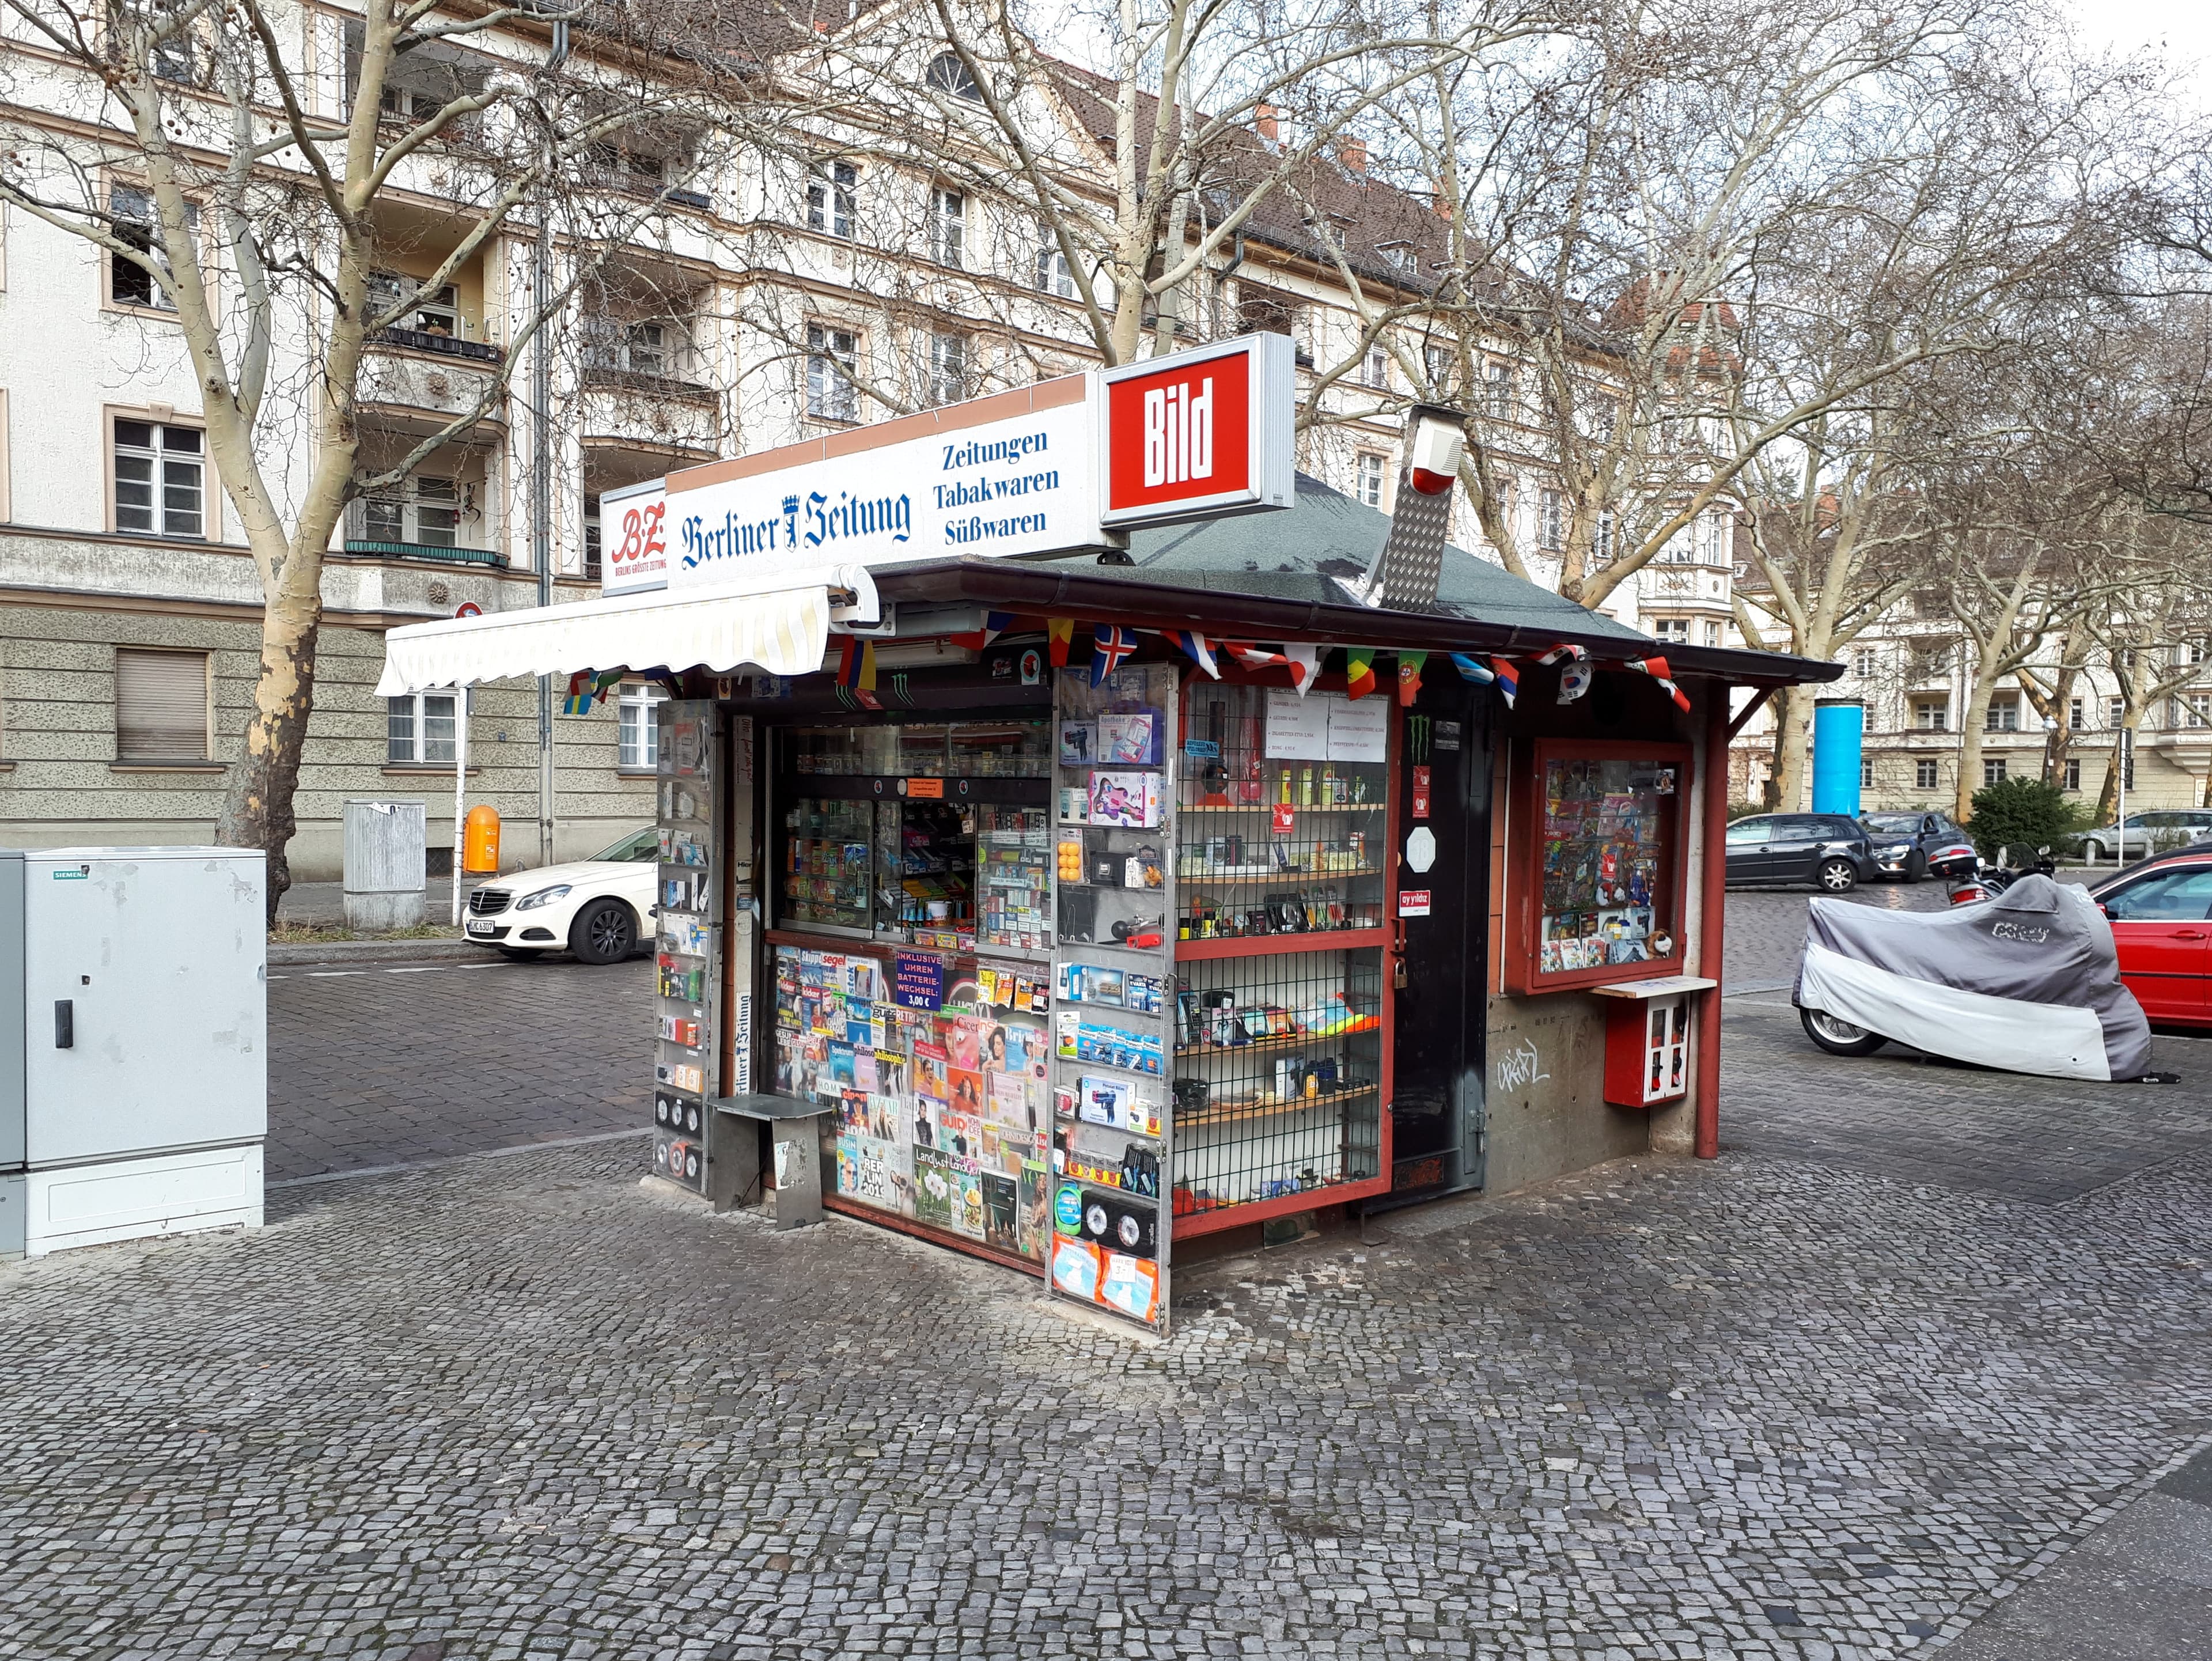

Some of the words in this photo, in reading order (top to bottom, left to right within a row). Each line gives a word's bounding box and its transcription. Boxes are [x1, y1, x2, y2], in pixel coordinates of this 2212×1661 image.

[1144, 377, 1213, 488] Bild
[942, 432, 1048, 471] Zeitungen
[933, 470, 1059, 509] Tabakwaren
[681, 509, 779, 570] Berliner
[804, 491, 911, 548] Zeitung
[945, 512, 1047, 546] Süßwaren
[615, 563, 631, 577] BERLINS
[632, 561, 649, 574] GRÖSSTE
[650, 558, 666, 573] ZEITUNG
[1402, 896, 1410, 906] ay
[479, 923, 493, 932] 6307
[823, 954, 846, 968] segel
[897, 952, 941, 964] INKLUSIVE
[904, 963, 933, 974] UHREN
[897, 973, 940, 986] BATTERIE-
[802, 986, 820, 998] kicker
[897, 983, 938, 997] WECHSEL:
[908, 994, 923, 1007] 3,00
[925, 997, 930, 1007] €
[1078, 1029, 1097, 1038] Panasonic
[832, 1045, 853, 1057] Spektrum
[854, 1046, 874, 1057] philoso
[838, 1138, 856, 1150] BUSIN
[864, 1157, 883, 1174] BER
[866, 1170, 882, 1186] LIN
